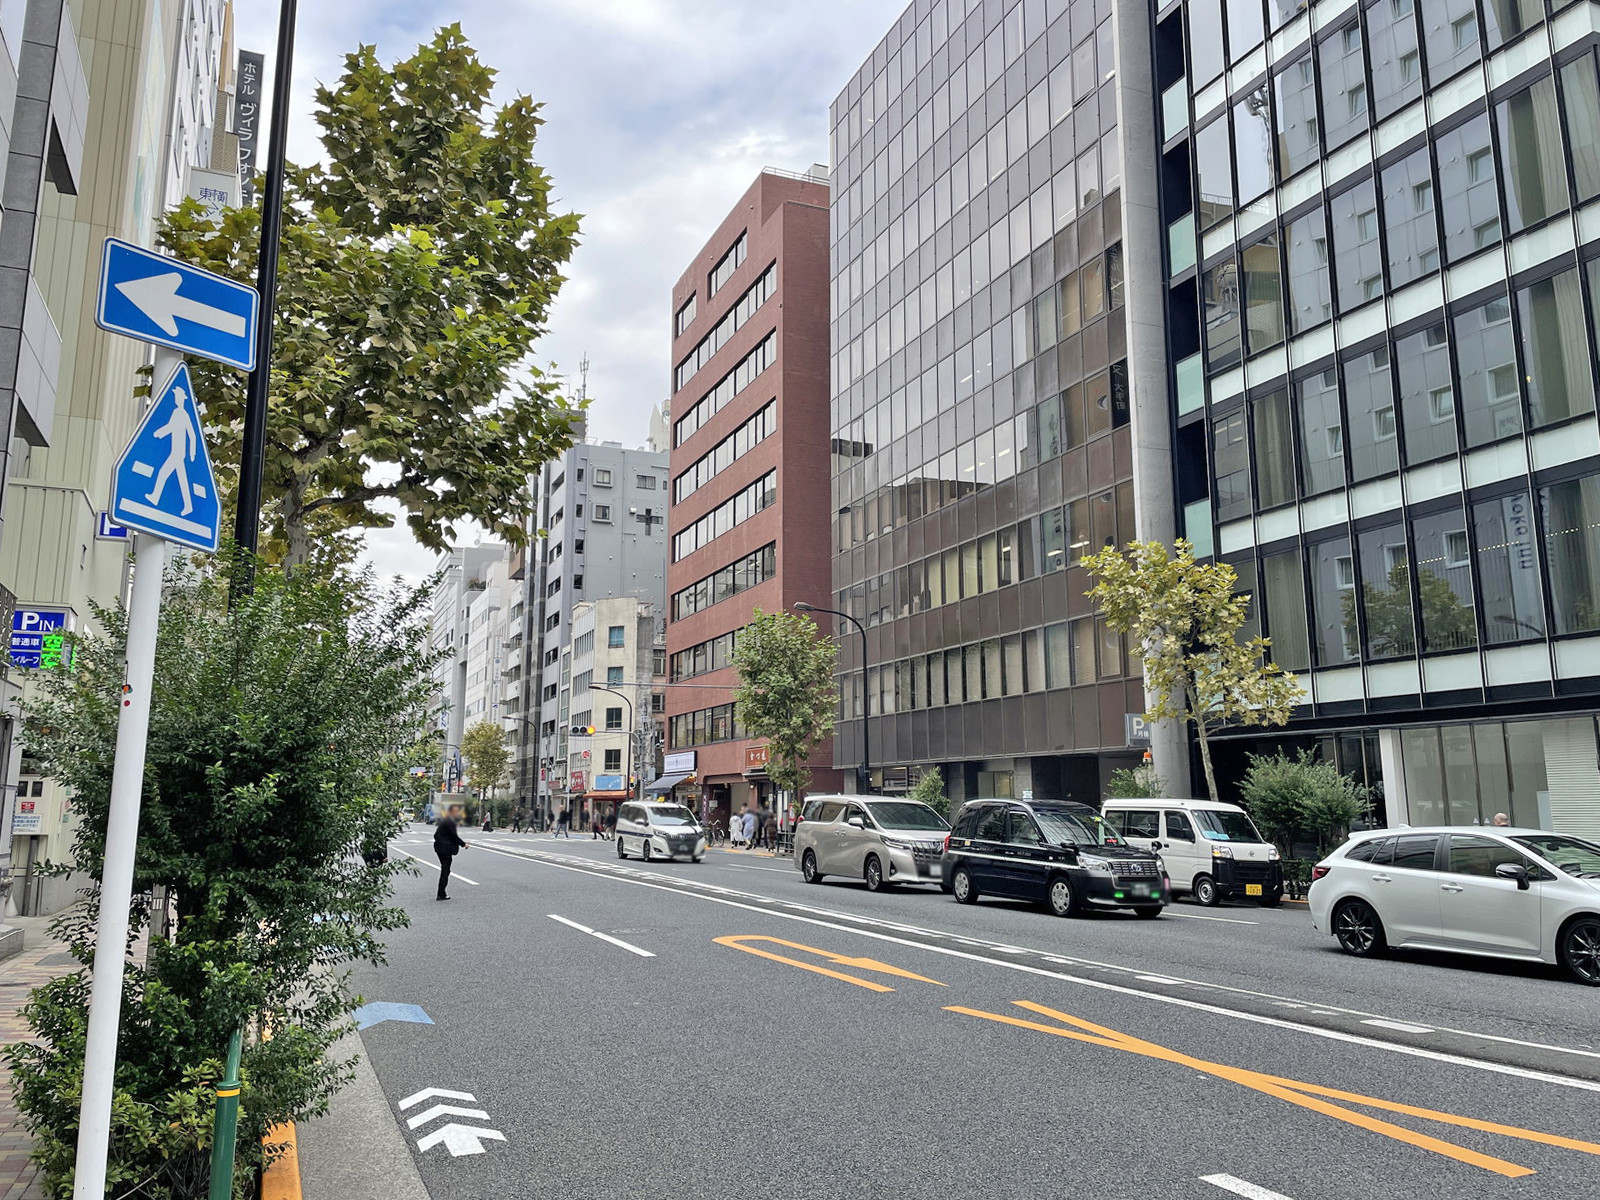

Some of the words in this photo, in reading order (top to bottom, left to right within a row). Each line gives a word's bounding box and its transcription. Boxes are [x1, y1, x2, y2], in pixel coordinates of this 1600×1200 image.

[242, 62, 257, 95] ホテル
[238, 102, 257, 141] ヴィラ
[12, 637, 40, 646] 普通車
[1132, 717, 1144, 735] P
